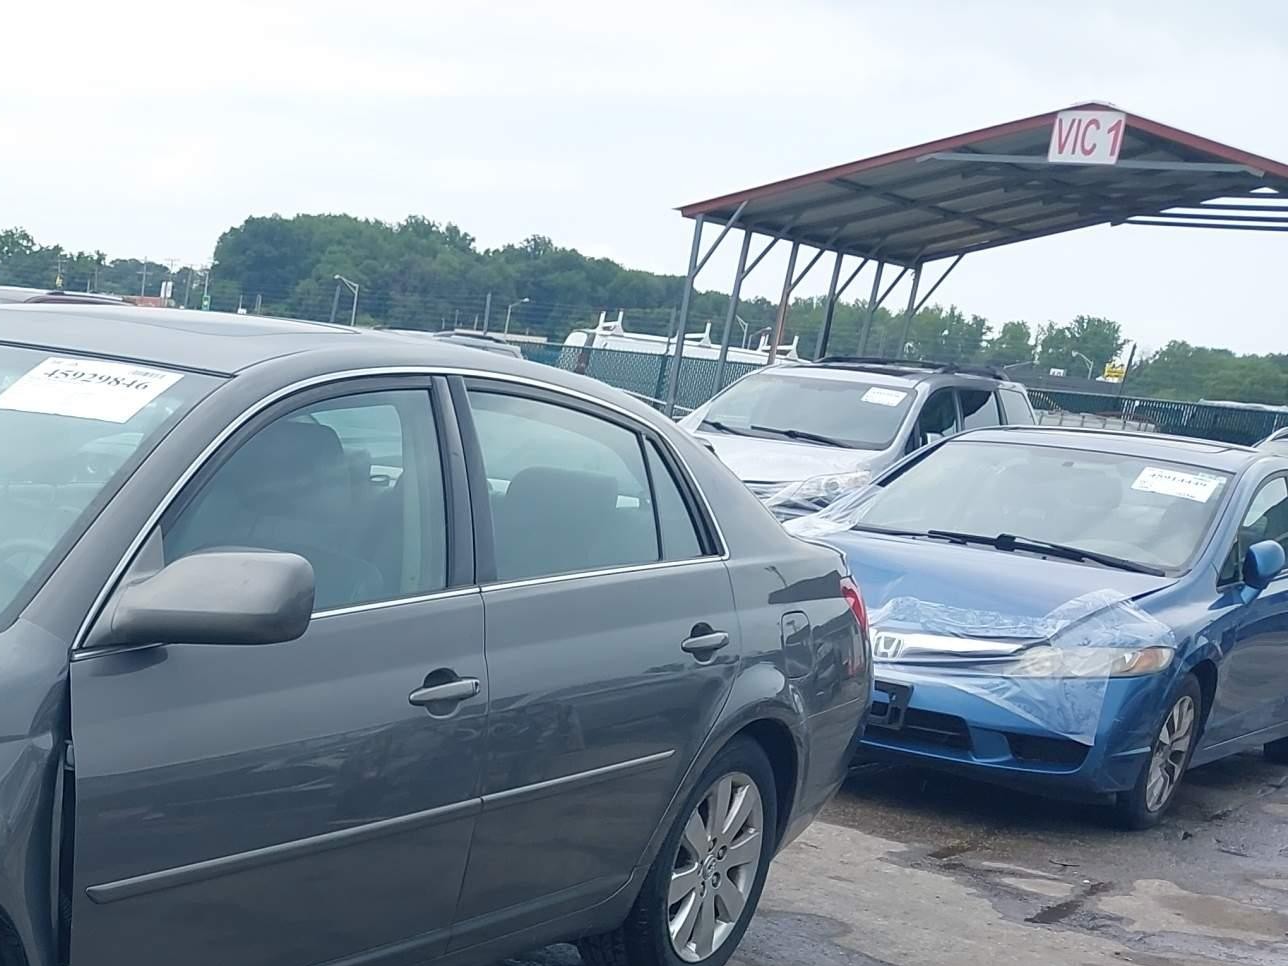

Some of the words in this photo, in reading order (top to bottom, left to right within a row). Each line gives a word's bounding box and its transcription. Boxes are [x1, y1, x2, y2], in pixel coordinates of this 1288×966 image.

[1057, 118, 1101, 156] VIC
[1107, 119, 1123, 157] 1
[43, 367, 150, 391] 45929846
